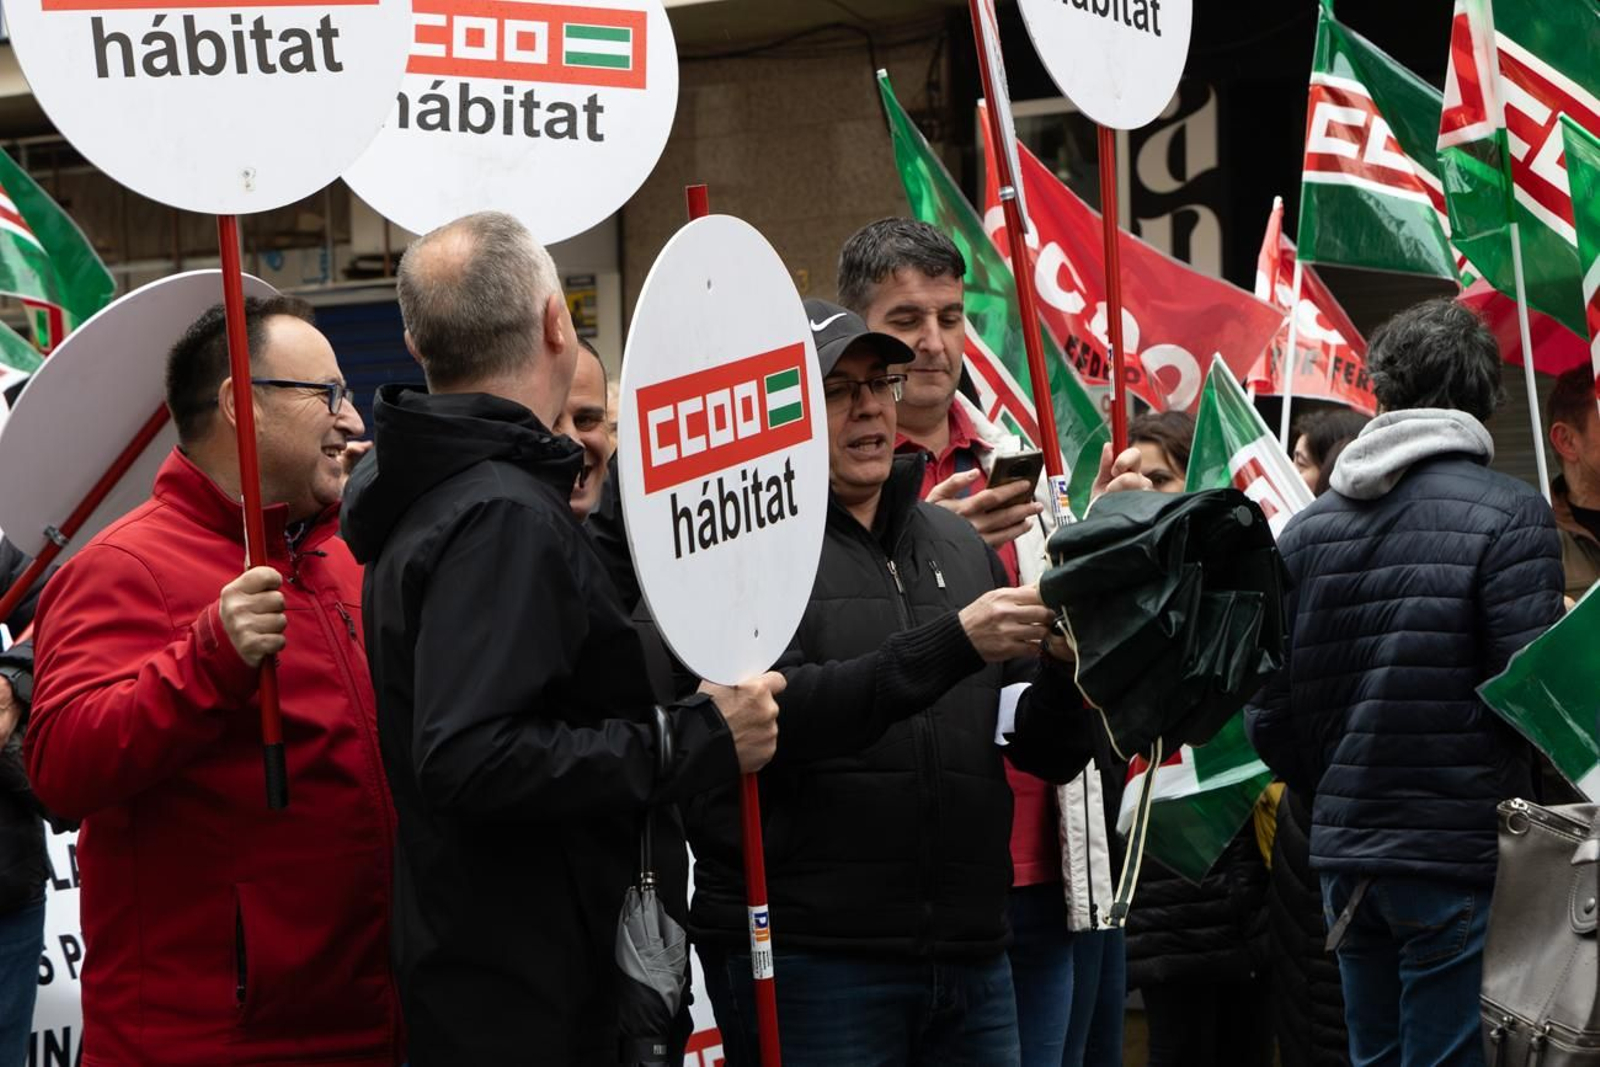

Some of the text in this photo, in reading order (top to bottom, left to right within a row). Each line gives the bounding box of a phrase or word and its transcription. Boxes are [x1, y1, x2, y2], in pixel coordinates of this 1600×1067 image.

[91, 14, 343, 78] hábitat
[410, 12, 549, 64] COO
[1056, 0, 1162, 37] itat
[1333, 356, 1376, 394] FER
[647, 380, 761, 467] CCOO
[670, 457, 798, 558] hábitat
